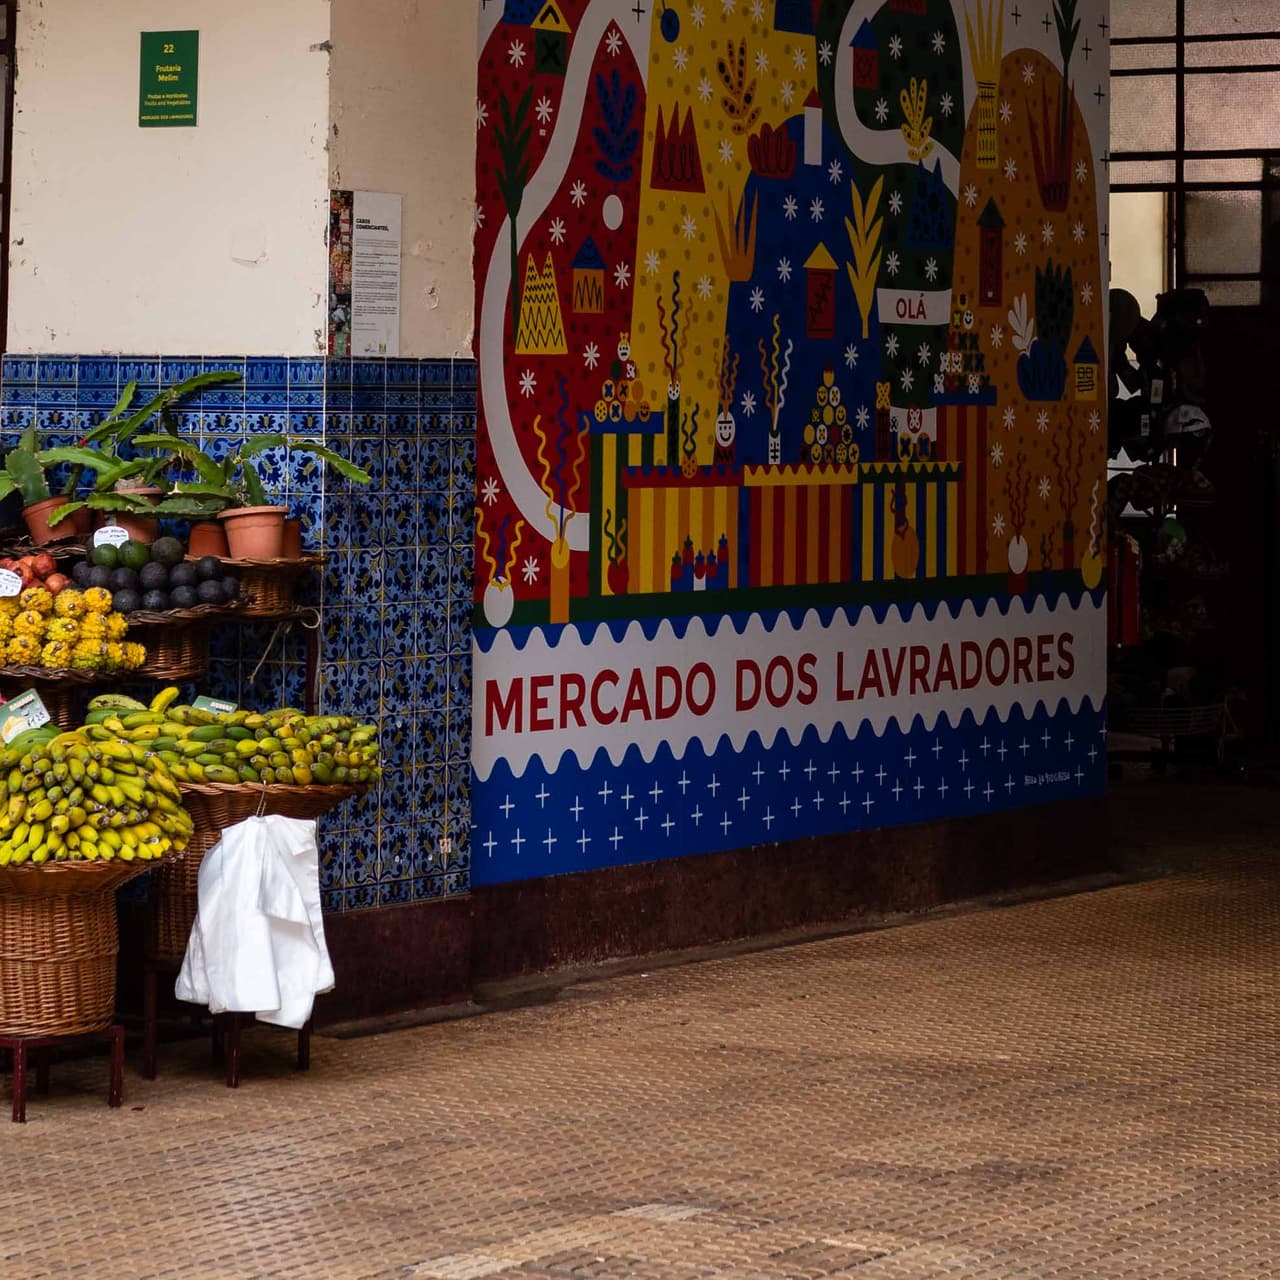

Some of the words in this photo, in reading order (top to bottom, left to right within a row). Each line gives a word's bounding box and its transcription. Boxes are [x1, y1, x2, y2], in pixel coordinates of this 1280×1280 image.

[163, 44, 175, 54] 22
[896, 293, 927, 320] OLÁ
[485, 661, 716, 737] MERCADO
[736, 652, 818, 712] DOS
[836, 631, 1075, 702] LAVRADORES
